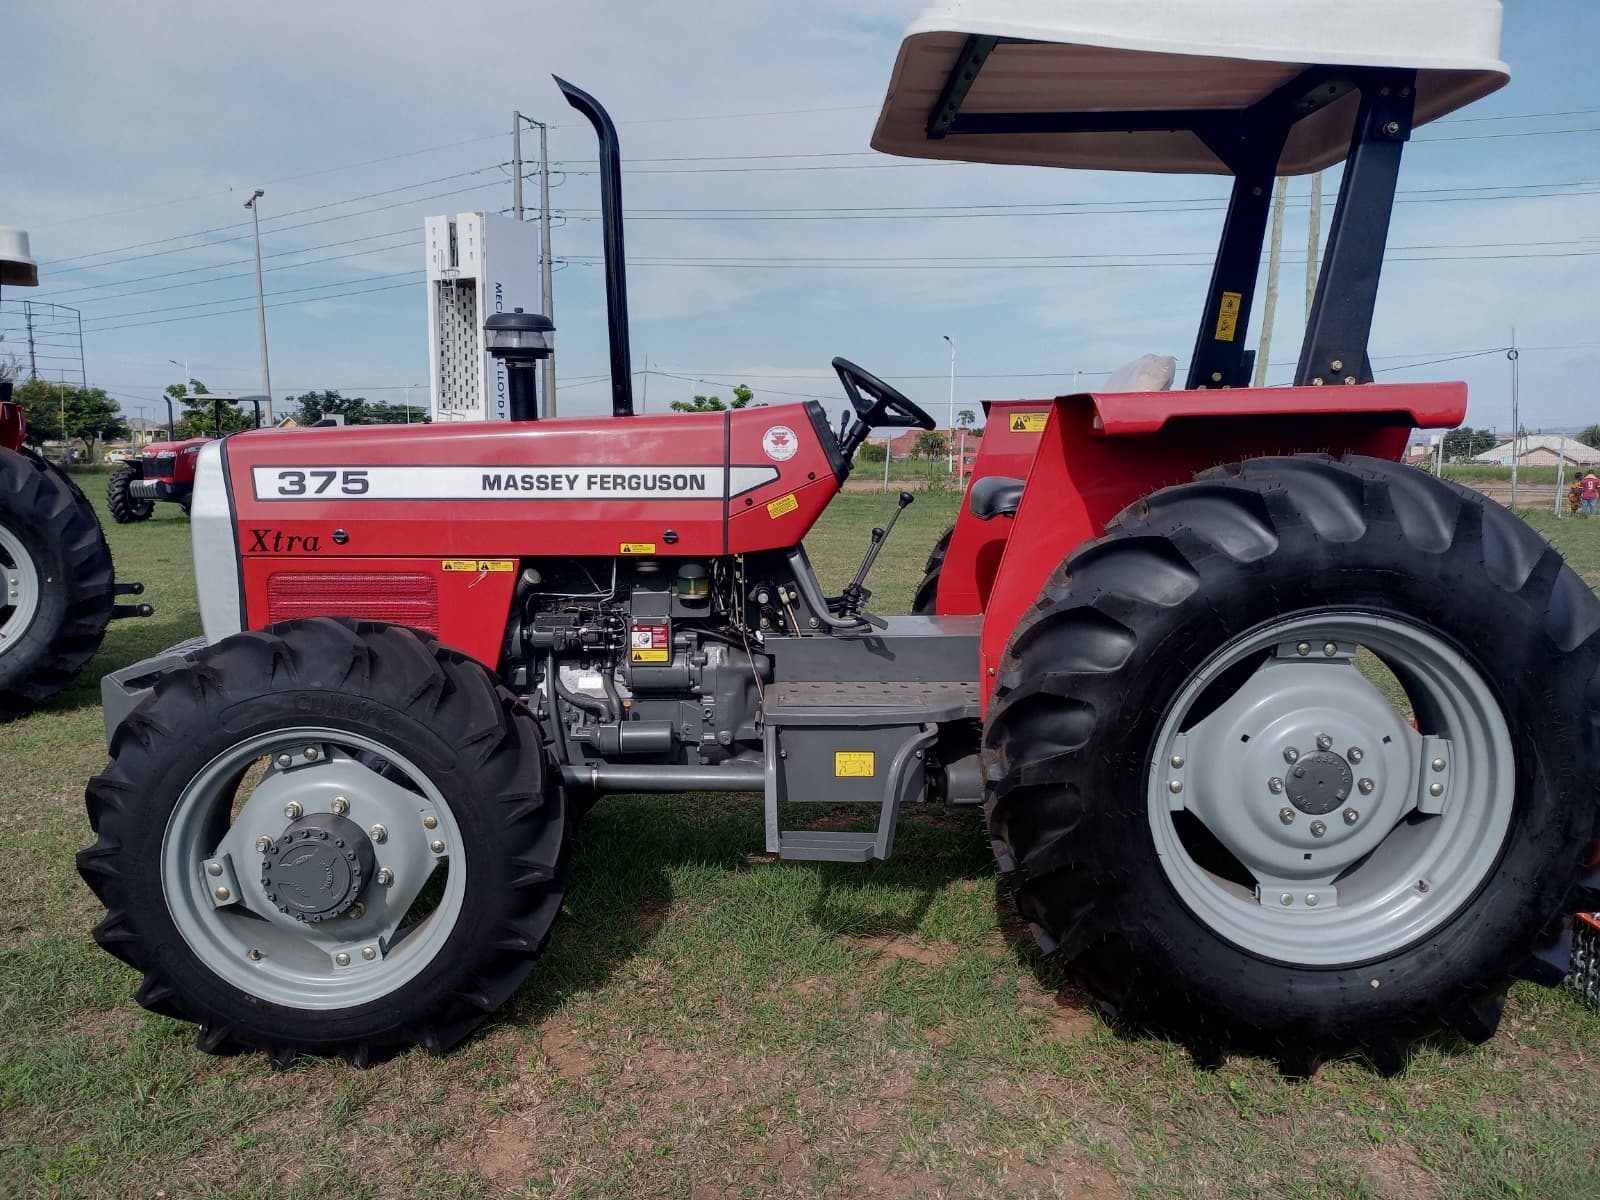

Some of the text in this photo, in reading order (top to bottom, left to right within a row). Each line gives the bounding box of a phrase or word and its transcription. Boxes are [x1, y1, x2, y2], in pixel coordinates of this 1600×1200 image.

[497, 371, 505, 409] LLOYD
[278, 471, 706, 495] 375 MASSEY FERGUSON
[248, 529, 321, 552] Xtra
